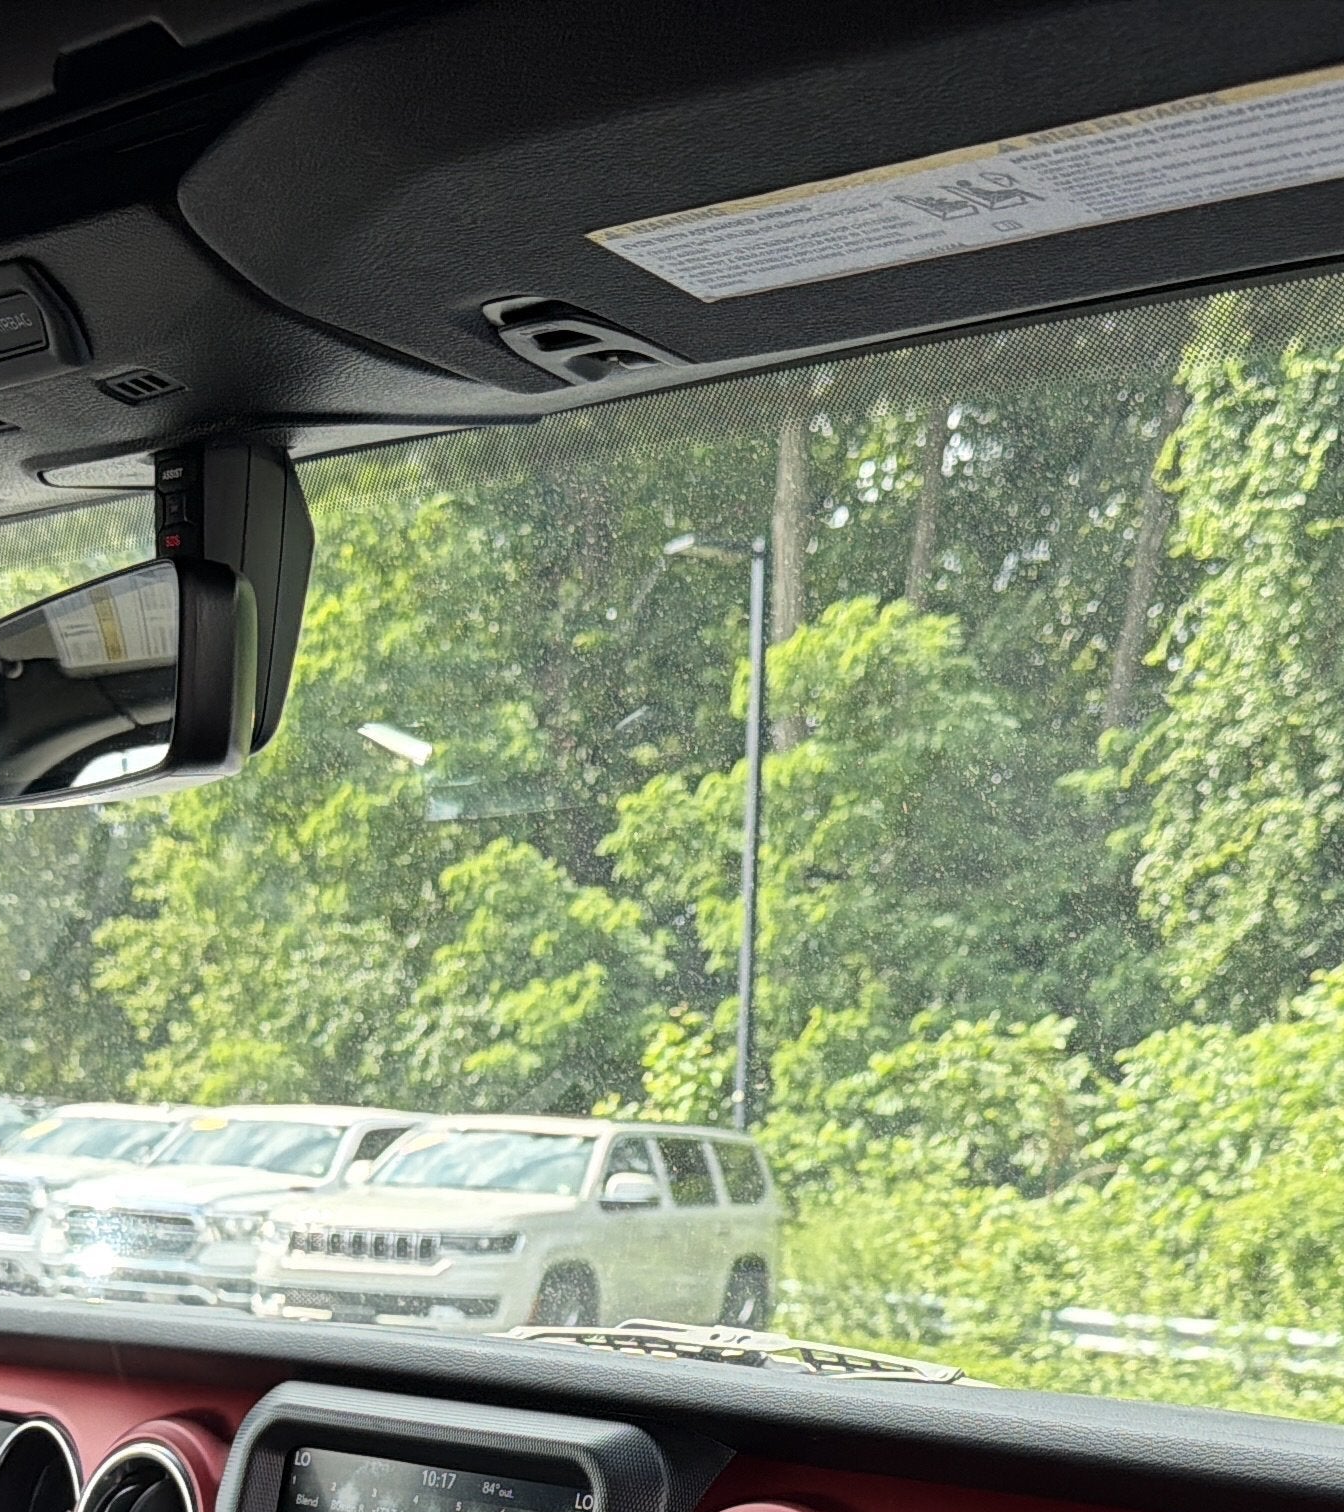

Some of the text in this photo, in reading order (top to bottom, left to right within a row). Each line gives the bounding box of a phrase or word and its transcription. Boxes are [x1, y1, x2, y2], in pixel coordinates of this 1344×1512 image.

[162, 467, 183, 480] ASSIST
[294, 1450, 311, 1467] LO
[422, 1470, 456, 1489] 10:17
[296, 1494, 319, 1507] Blend
[575, 1493, 593, 1510] LO
